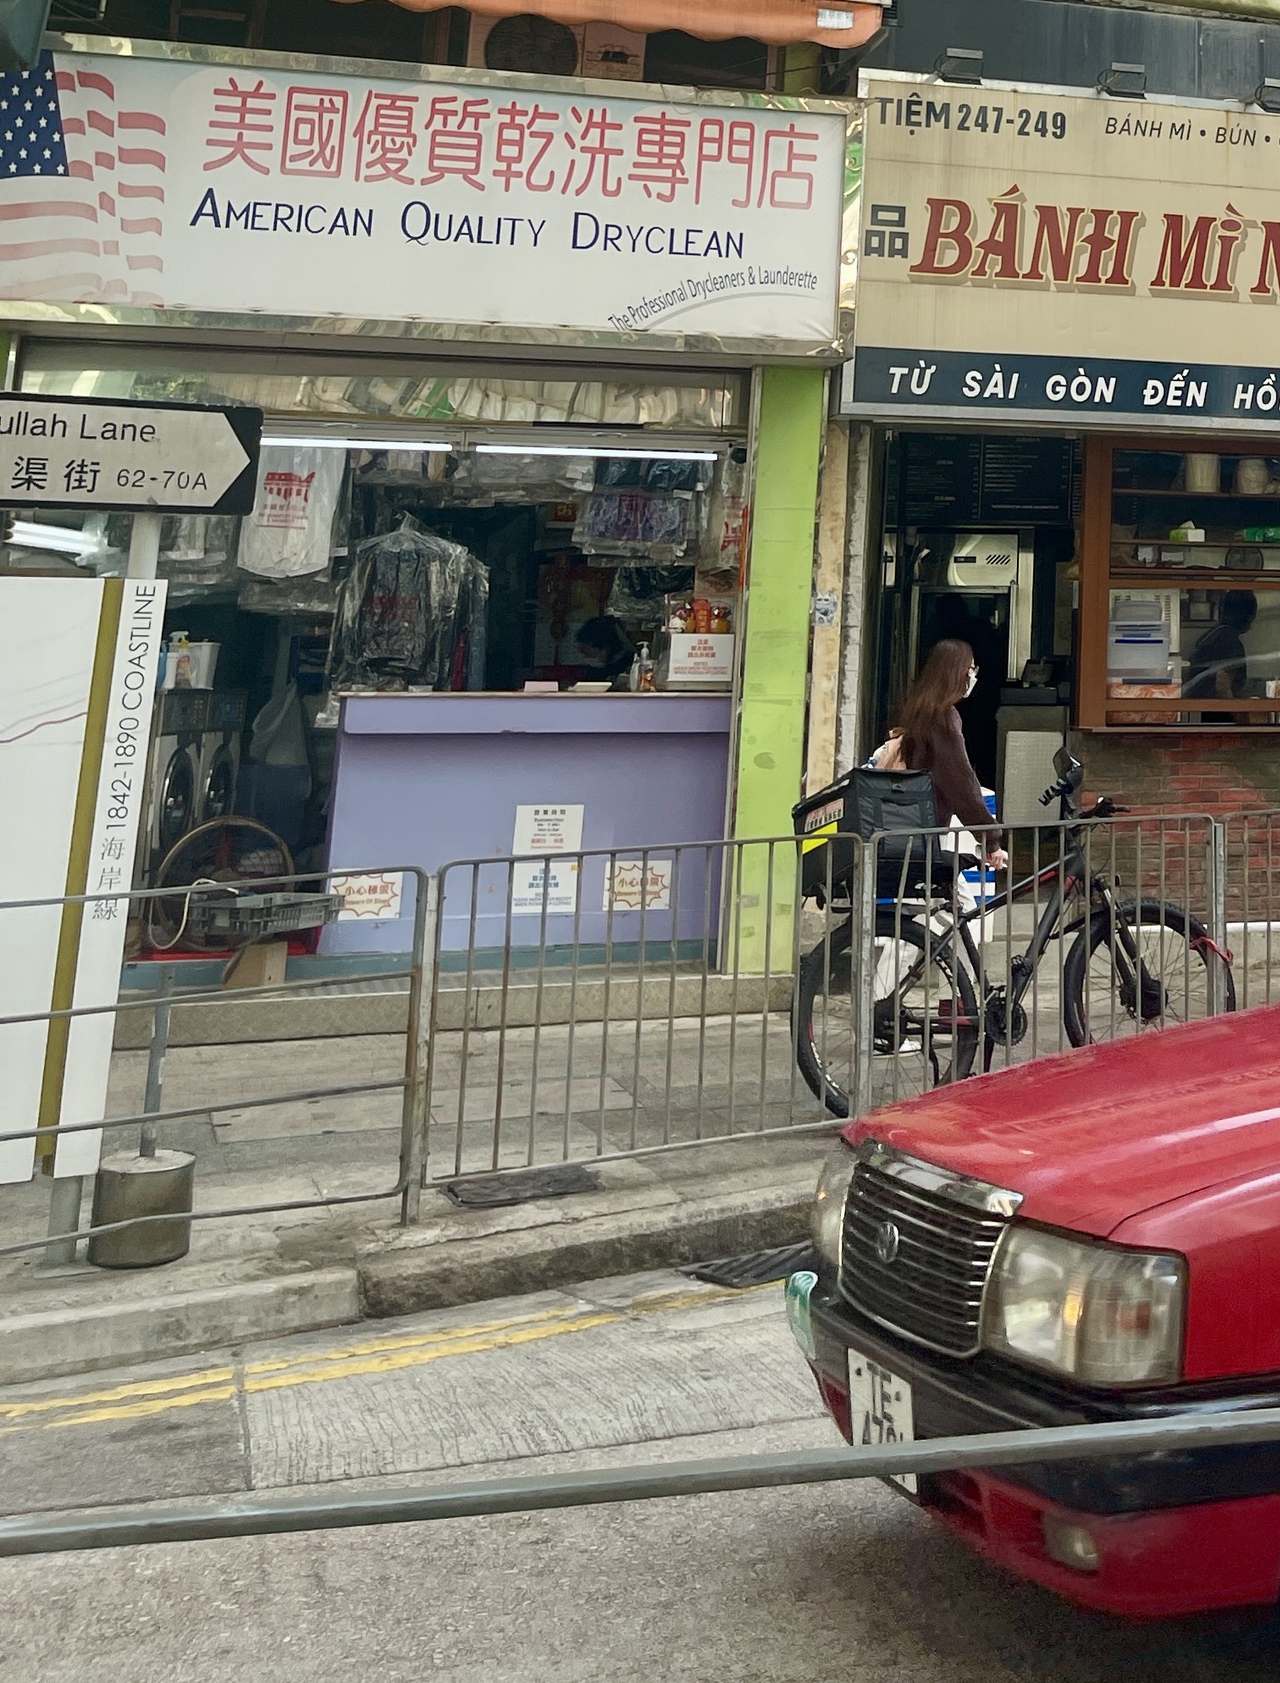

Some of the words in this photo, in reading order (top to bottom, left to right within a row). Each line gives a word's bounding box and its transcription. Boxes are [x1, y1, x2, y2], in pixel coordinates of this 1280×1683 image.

[203, 76, 820, 210] 美國優質乾洗專門店
[875, 96, 951, 135] TIỆM
[957, 103, 1067, 140] 247-249
[1104, 115, 1163, 141] BÁNH
[1168, 117, 1192, 141] MÌ
[1214, 120, 1256, 148] BÚN
[189, 187, 374, 237] AMERICAN
[400, 200, 546, 248] QUALITY
[571, 211, 744, 259] DRYCLEAN
[864, 204, 910, 260] 品
[909, 184, 1140, 287] BÁNH
[628, 282, 688, 322] Professional
[687, 269, 746, 298] Drycleaners
[747, 266, 756, 285] &
[758, 265, 818, 290] Launderette
[887, 359, 936, 395] TỪ
[962, 363, 1021, 399] SÀI
[1045, 366, 1117, 403] GÒN
[1142, 368, 1209, 408] ĐẾN
[80, 413, 157, 442] Lane
[11, 455, 101, 493] 渠街
[117, 468, 208, 491] 62-70A
[122, 585, 156, 711] COASTLINE
[106, 716, 140, 830] 1842-1890
[92, 836, 125, 921] 海岸線
